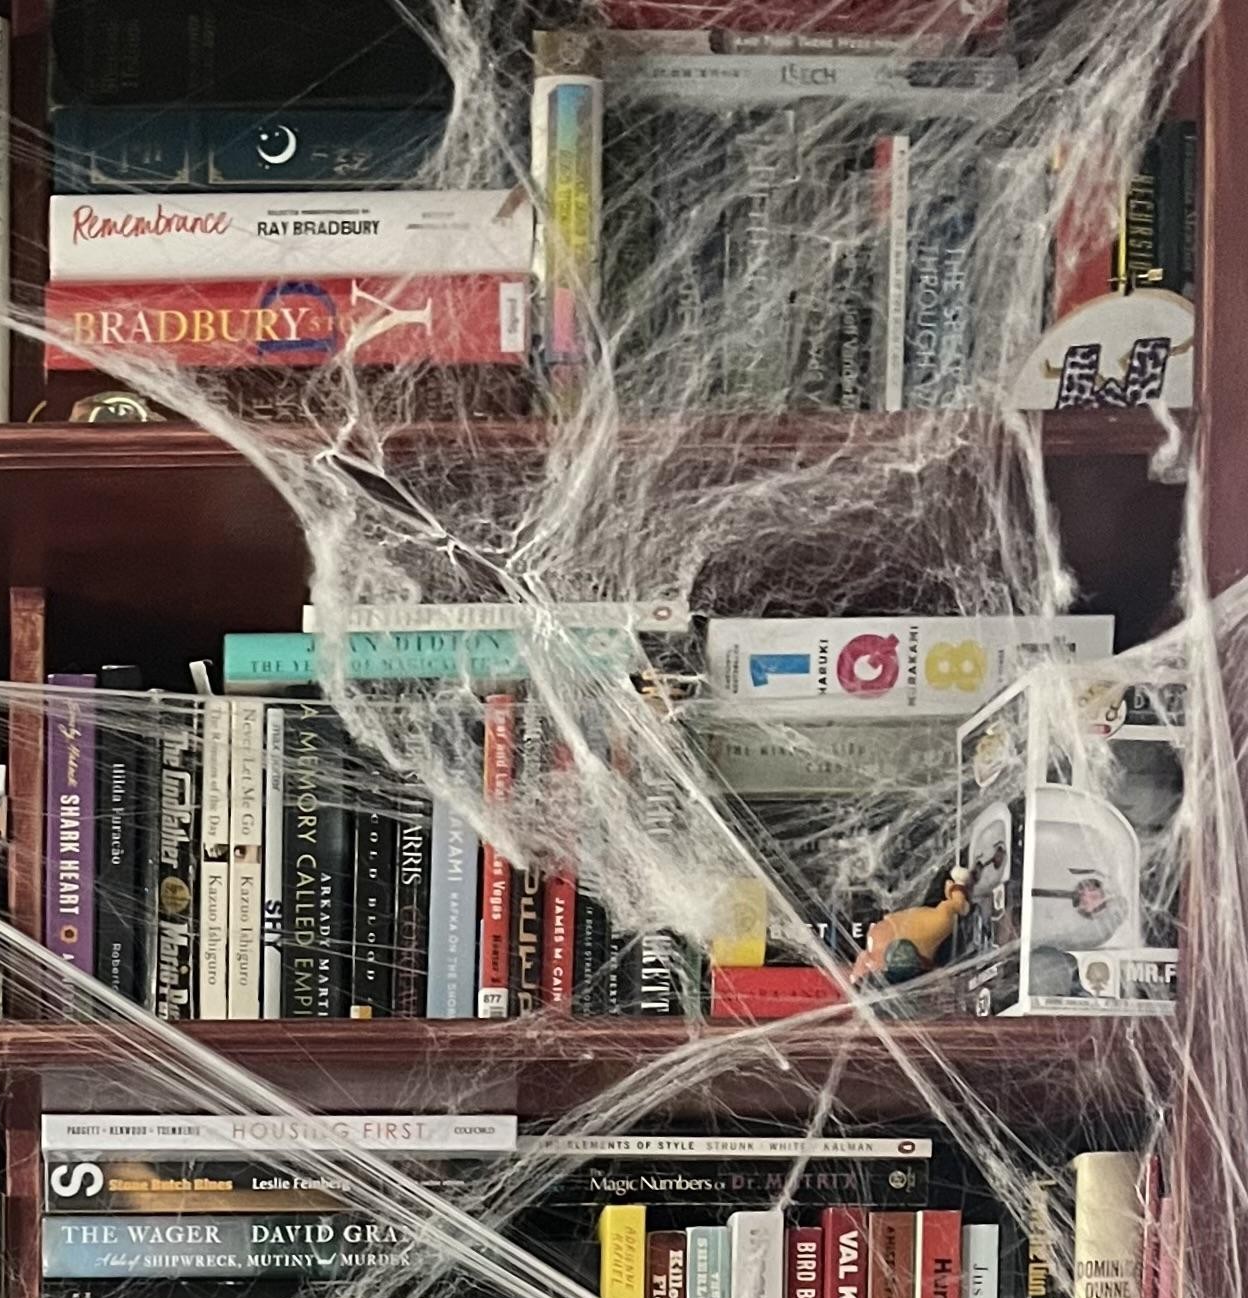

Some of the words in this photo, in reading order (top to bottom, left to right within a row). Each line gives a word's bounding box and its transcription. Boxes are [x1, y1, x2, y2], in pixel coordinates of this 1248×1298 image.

[72, 204, 233, 245] Remembrance
[257, 221, 289, 237] RAY
[293, 219, 380, 237] BRADBURY
[73, 306, 307, 345] BRADBURY
[60, 795, 80, 855] SHARK
[58, 861, 79, 916] HEART
[61, 1225, 117, 1243] THE
[127, 1226, 222, 1244] WAGER
[797, 1242, 816, 1282] BIRD
[838, 1231, 858, 1279] VAL
